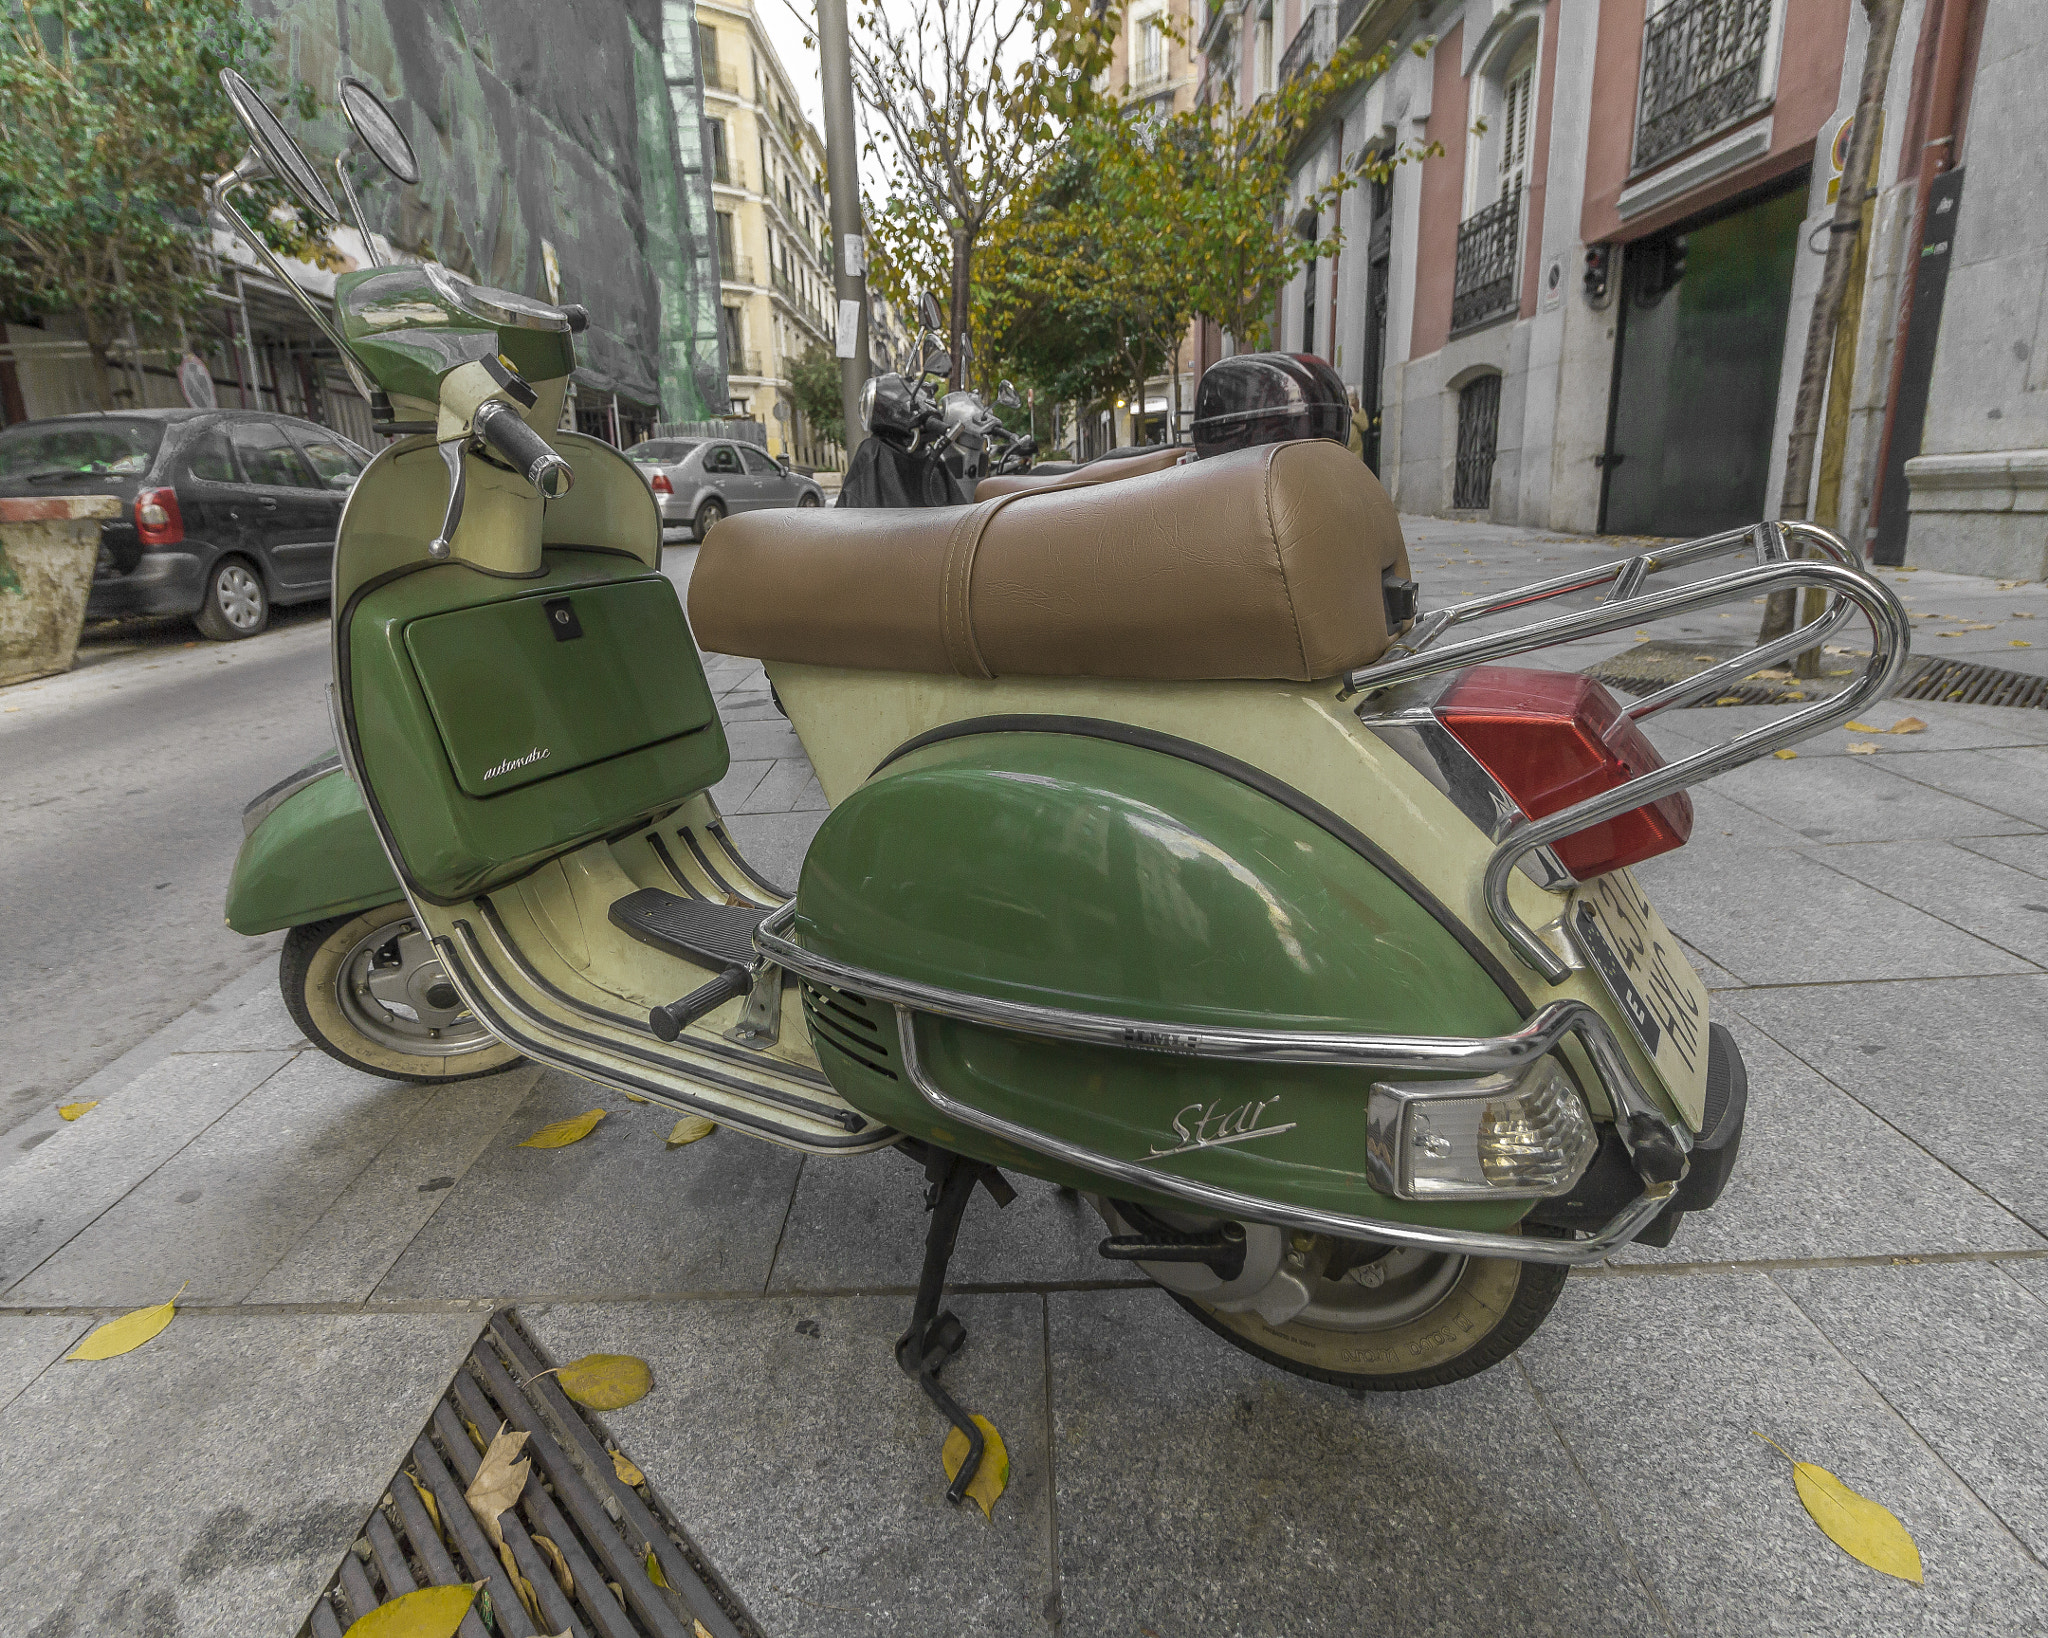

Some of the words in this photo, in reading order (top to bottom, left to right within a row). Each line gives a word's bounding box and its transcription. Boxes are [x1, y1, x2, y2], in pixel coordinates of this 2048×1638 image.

[483, 746, 551, 781] automatic
[1625, 988, 1645, 1025] E
[1646, 940, 1699, 1074] HXC
[1150, 1094, 1282, 1154] Star
